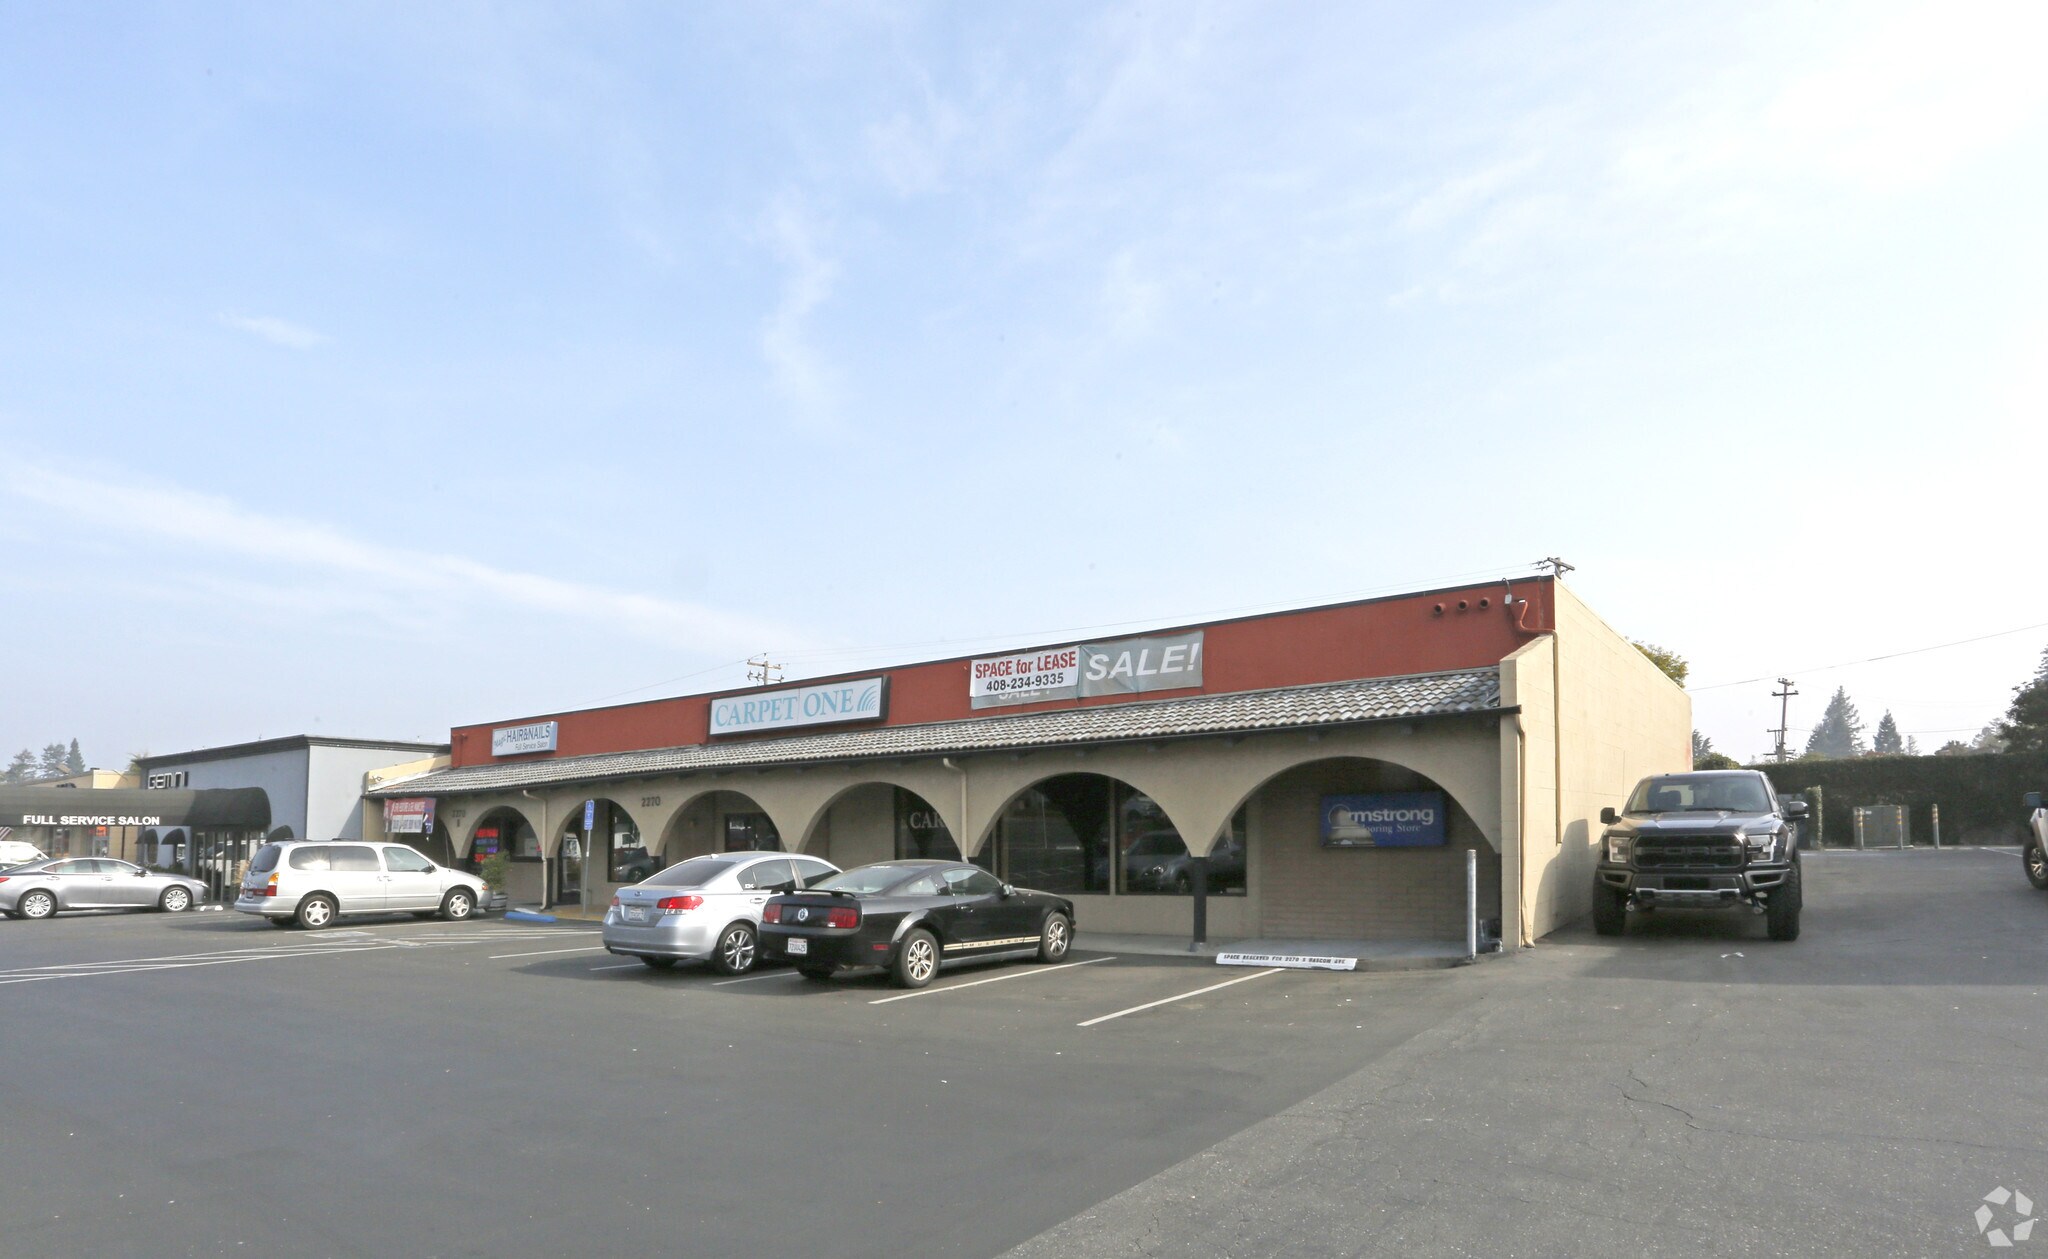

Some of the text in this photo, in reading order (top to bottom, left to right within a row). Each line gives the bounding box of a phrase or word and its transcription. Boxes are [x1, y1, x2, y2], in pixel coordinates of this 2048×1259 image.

[975, 651, 1077, 679] SPACE for LEASE
[1085, 642, 1200, 681] SALE!
[986, 672, 1064, 692] 408-234-9335
[715, 688, 853, 727] CARPET ONE
[506, 725, 551, 743] HAIR&NAILS
[641, 796, 661, 807] 2270
[23, 815, 160, 826] FULL SERVICE SALON
[1329, 804, 1434, 826] rmstrong
[1397, 824, 1421, 832] Store
